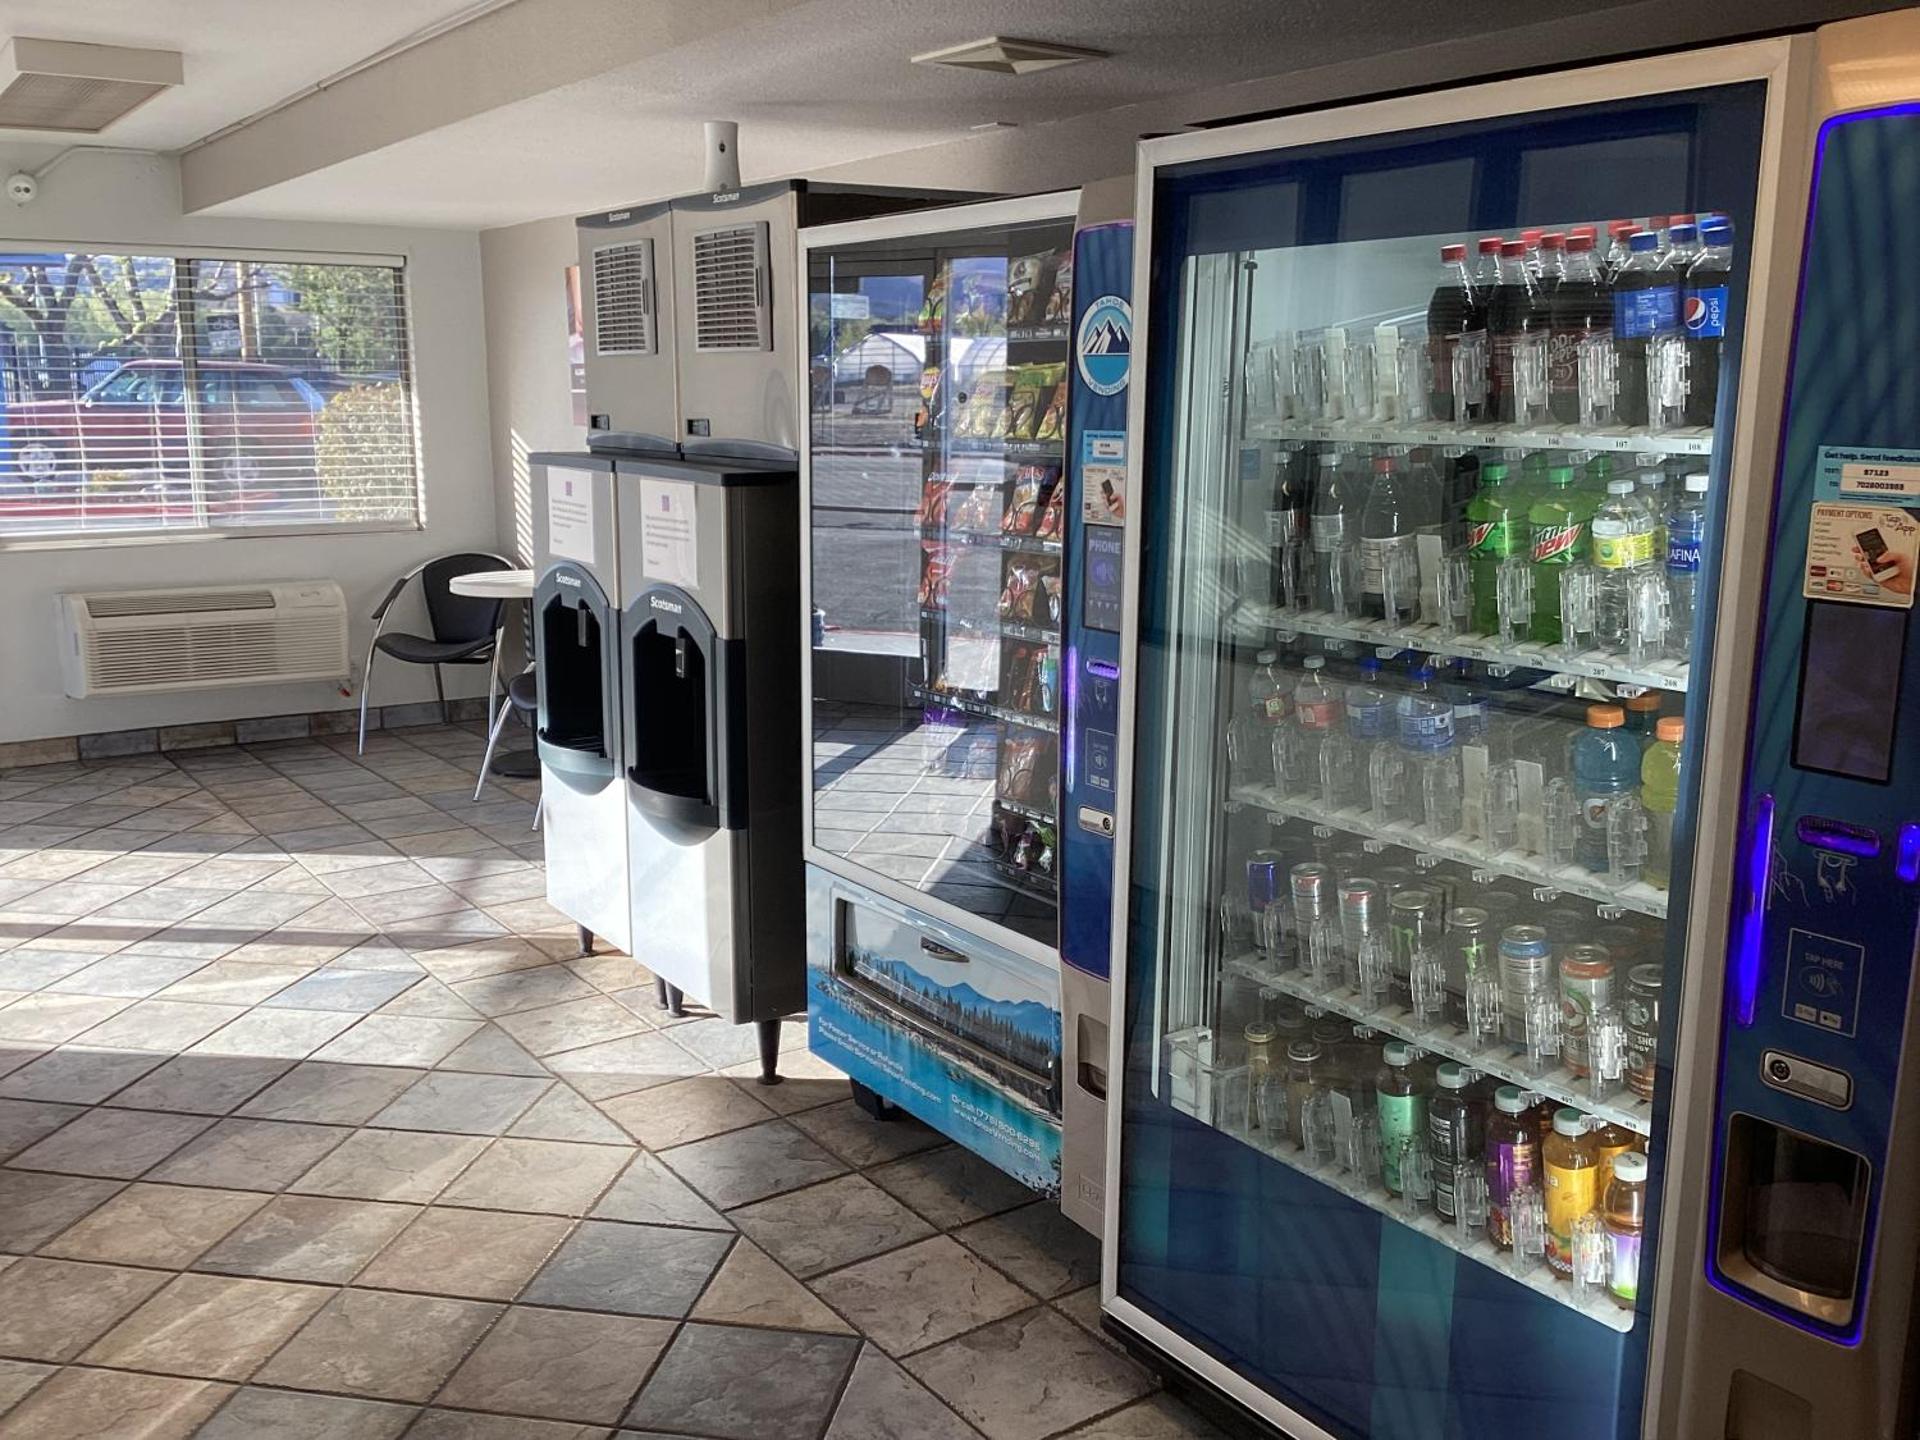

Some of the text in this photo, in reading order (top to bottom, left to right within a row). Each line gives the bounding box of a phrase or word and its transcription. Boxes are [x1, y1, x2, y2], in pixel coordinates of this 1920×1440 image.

[1095, 298, 1125, 309] TAHOE
[1711, 297, 1721, 327] pepsi
[1088, 378, 1126, 394] VENDING
[1615, 440, 1628, 448] 107
[1088, 538, 1121, 554] PHONE
[556, 572, 581, 587] Scotsman
[650, 595, 682, 614] Scotsman
[1593, 668, 1605, 676] 207
[1664, 679, 1677, 688] 208
